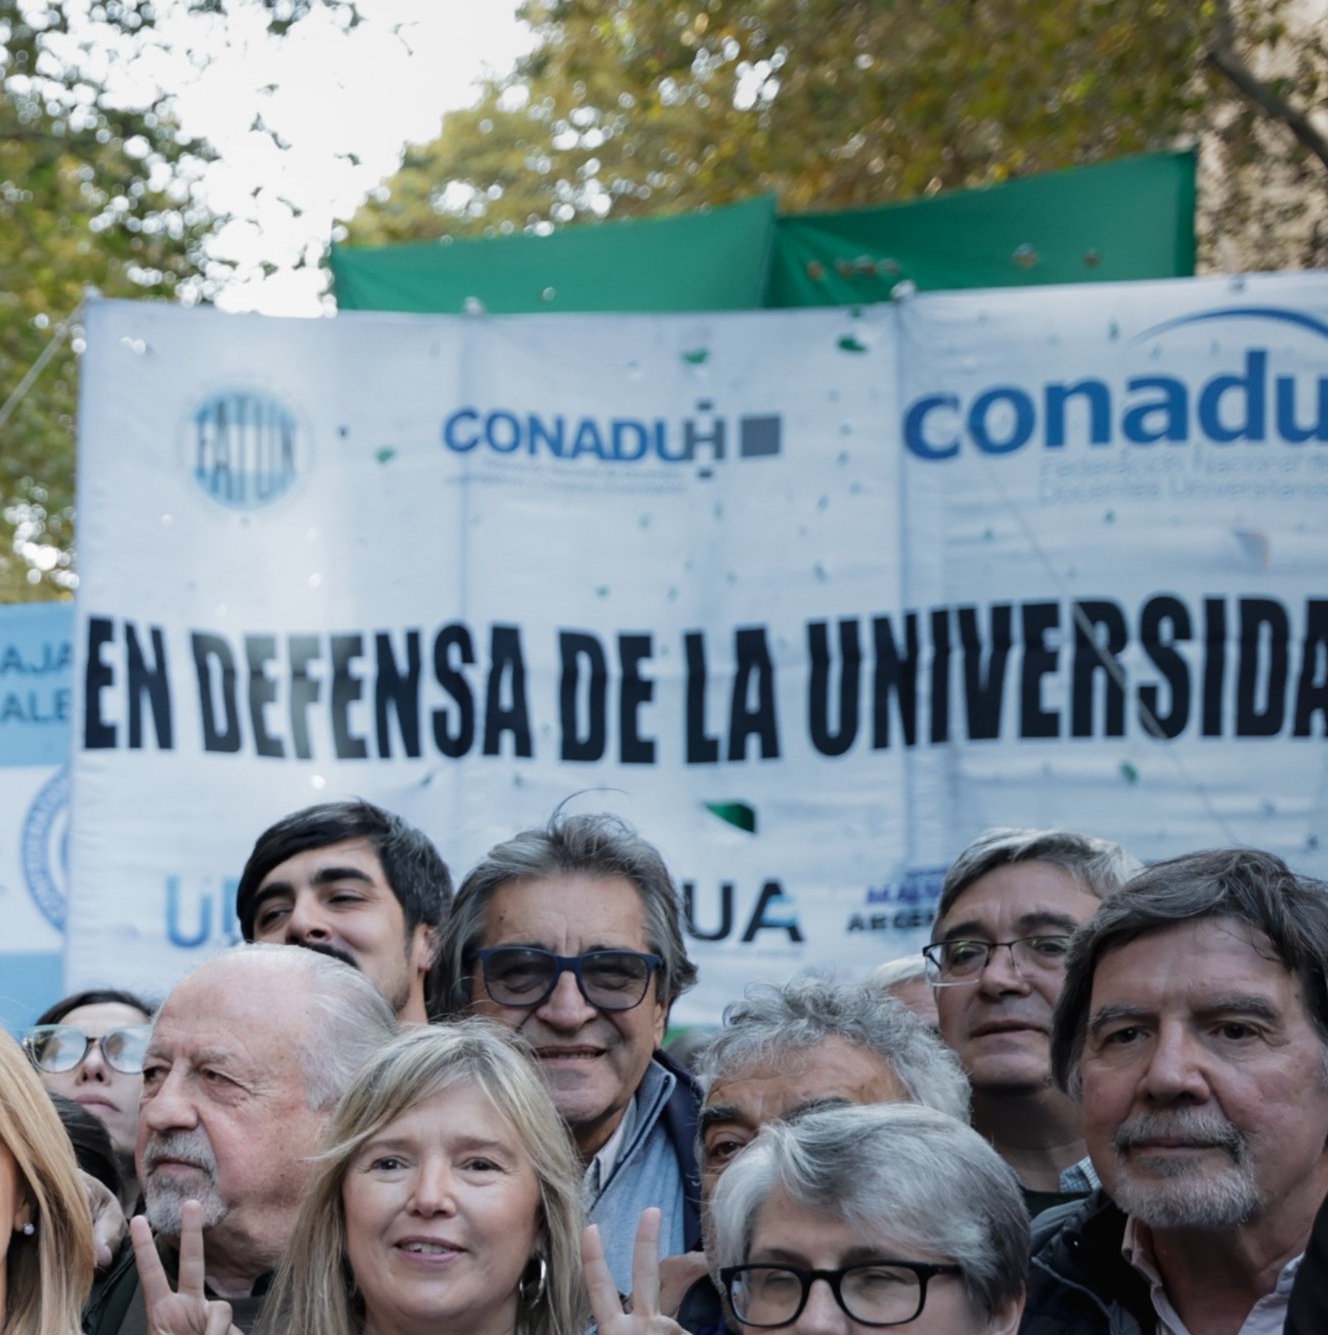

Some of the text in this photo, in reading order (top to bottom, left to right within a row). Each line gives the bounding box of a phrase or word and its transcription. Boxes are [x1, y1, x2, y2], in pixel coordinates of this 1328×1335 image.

[901, 348, 1328, 461] conadu
[83, 614, 174, 752] EN
[190, 621, 535, 760] DEFENSA
[558, 627, 659, 765] DE
[683, 624, 782, 765] LA
